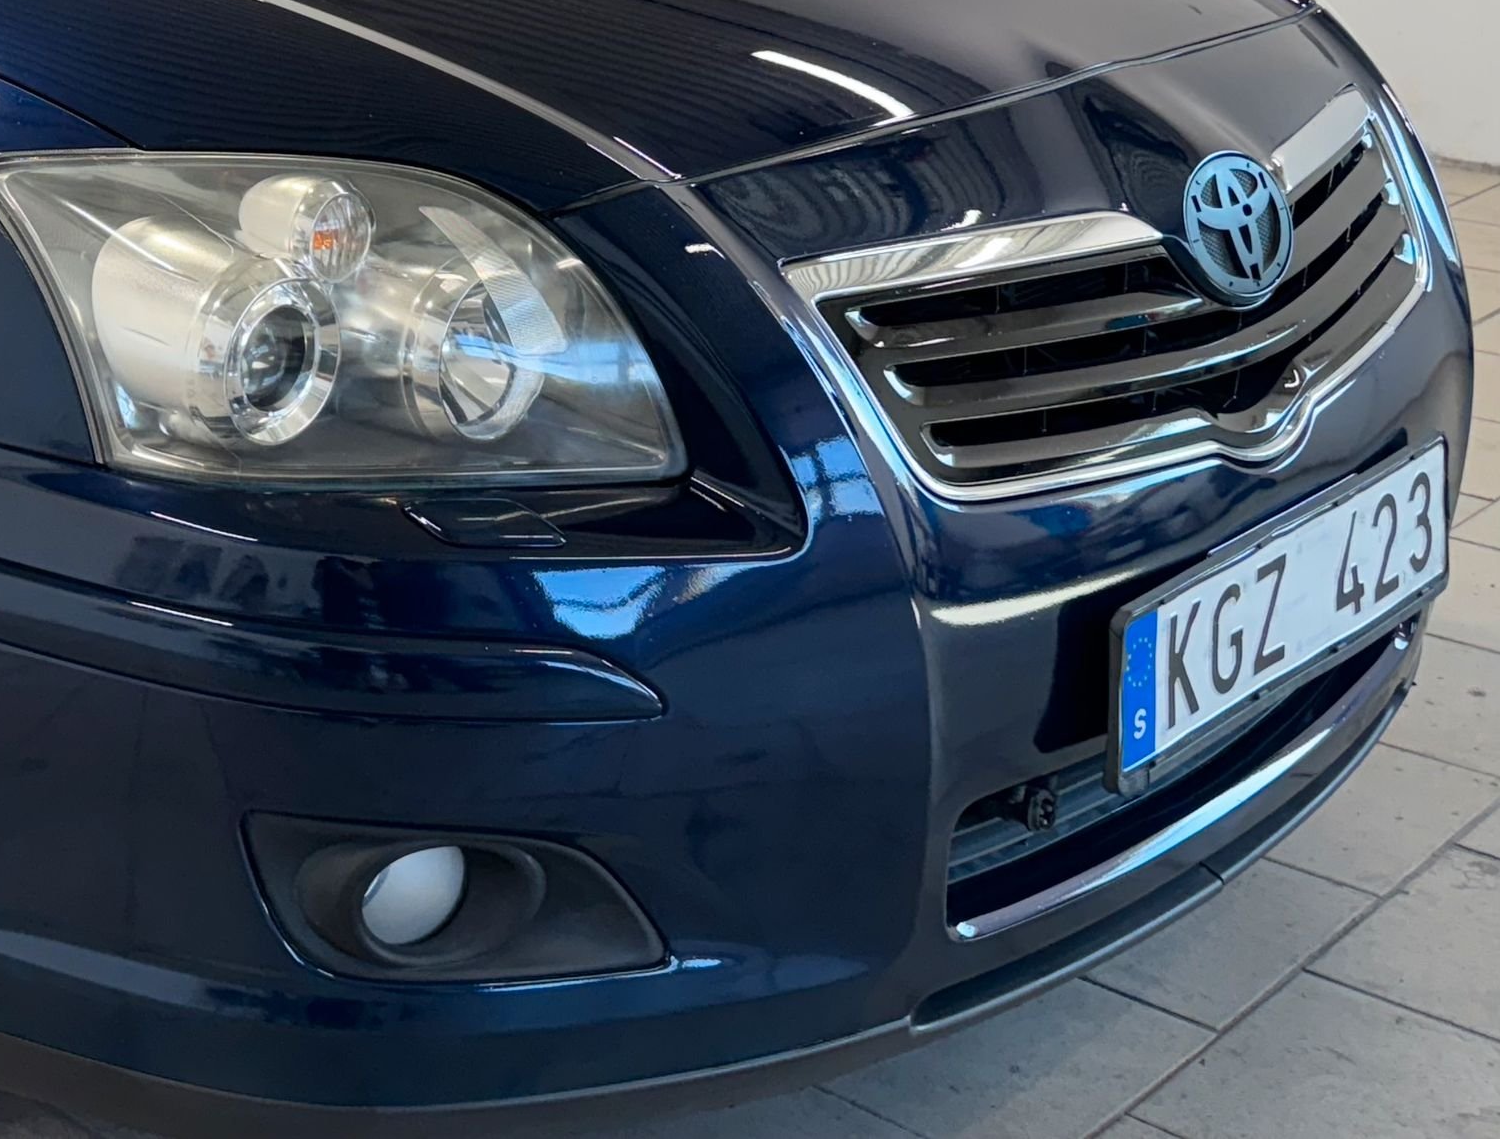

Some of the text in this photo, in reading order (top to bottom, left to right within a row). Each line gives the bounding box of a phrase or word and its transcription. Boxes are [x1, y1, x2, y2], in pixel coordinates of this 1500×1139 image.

[1167, 471, 1433, 730] KGZ 423
[1133, 708, 1148, 740] S
